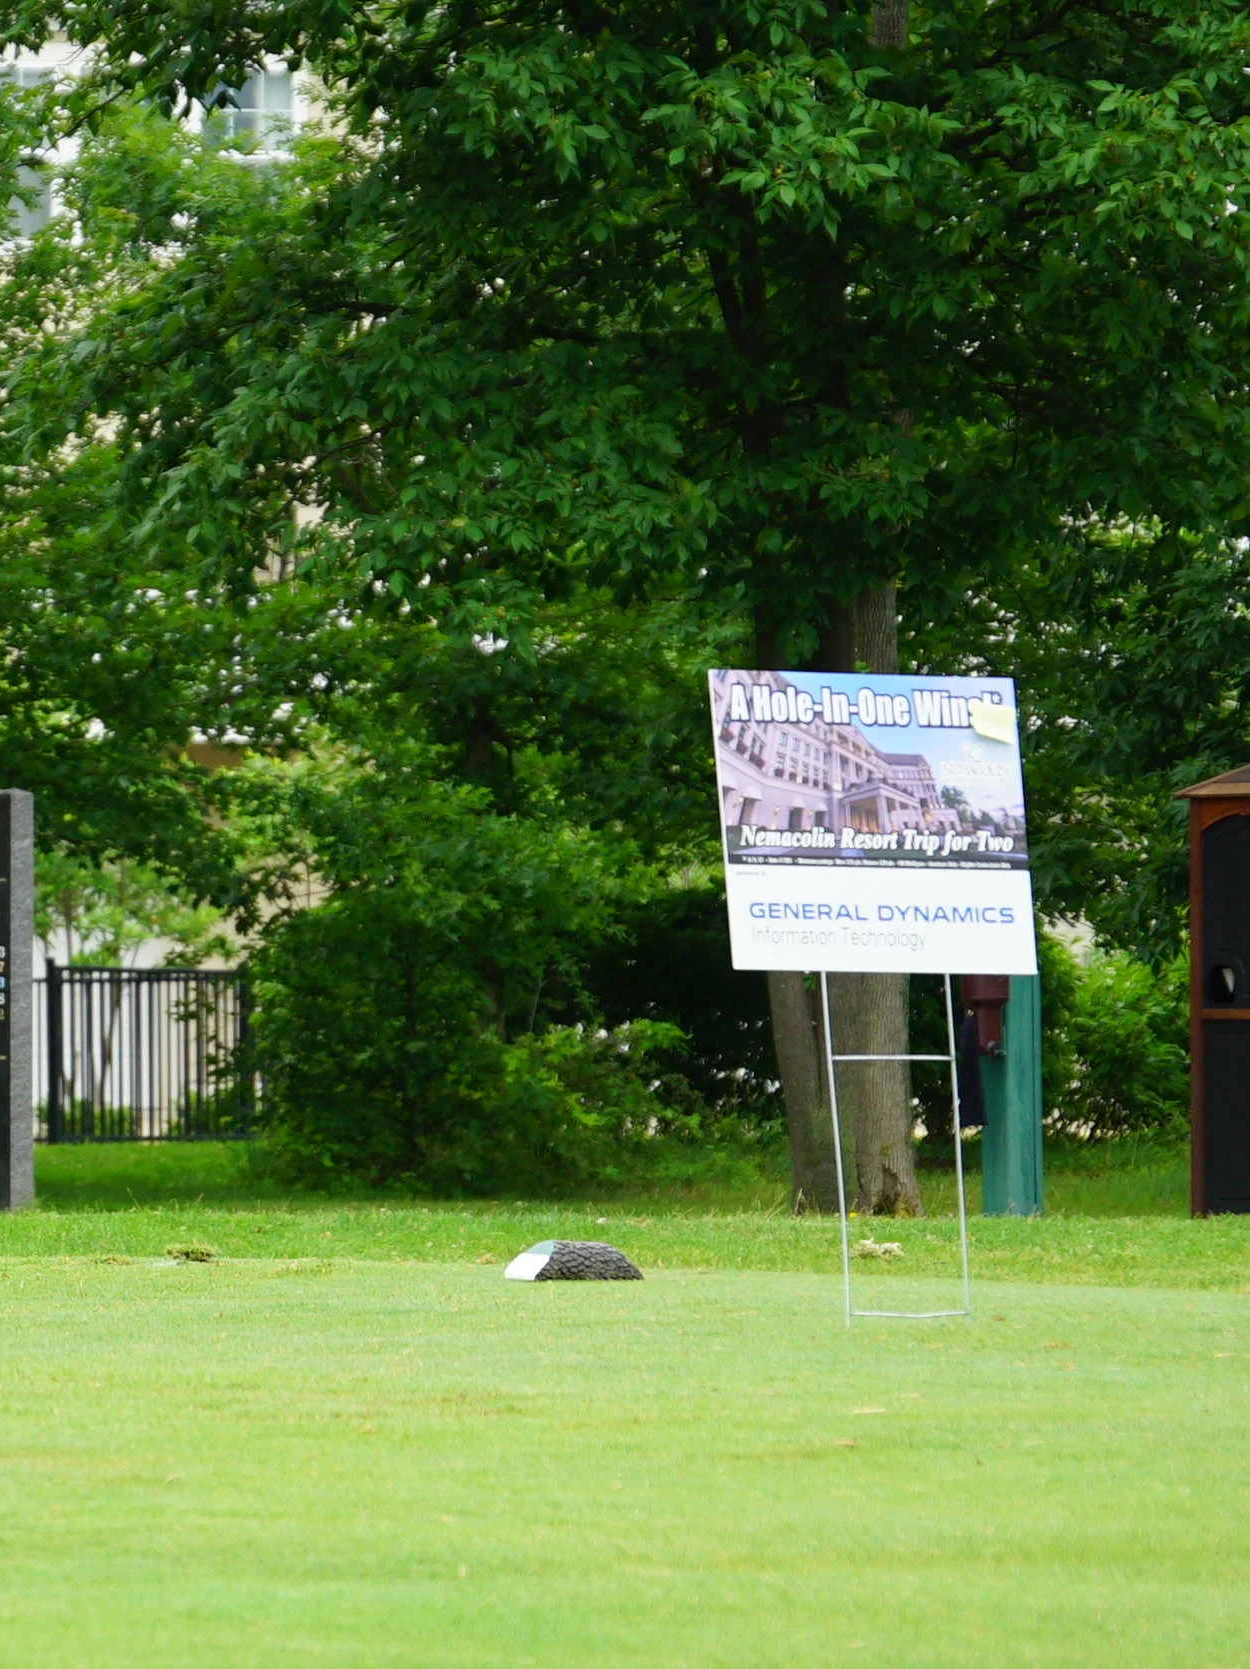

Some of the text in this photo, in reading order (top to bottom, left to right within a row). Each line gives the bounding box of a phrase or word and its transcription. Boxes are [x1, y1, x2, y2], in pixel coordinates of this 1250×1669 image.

[730, 684, 750, 721] A
[752, 684, 911, 727] Hole-In-One
[739, 824, 1014, 857] Nemacolin Resort Trip for Two
[749, 902, 1015, 924] GENERAL DYNAMICS
[751, 926, 927, 951] Information Technology
